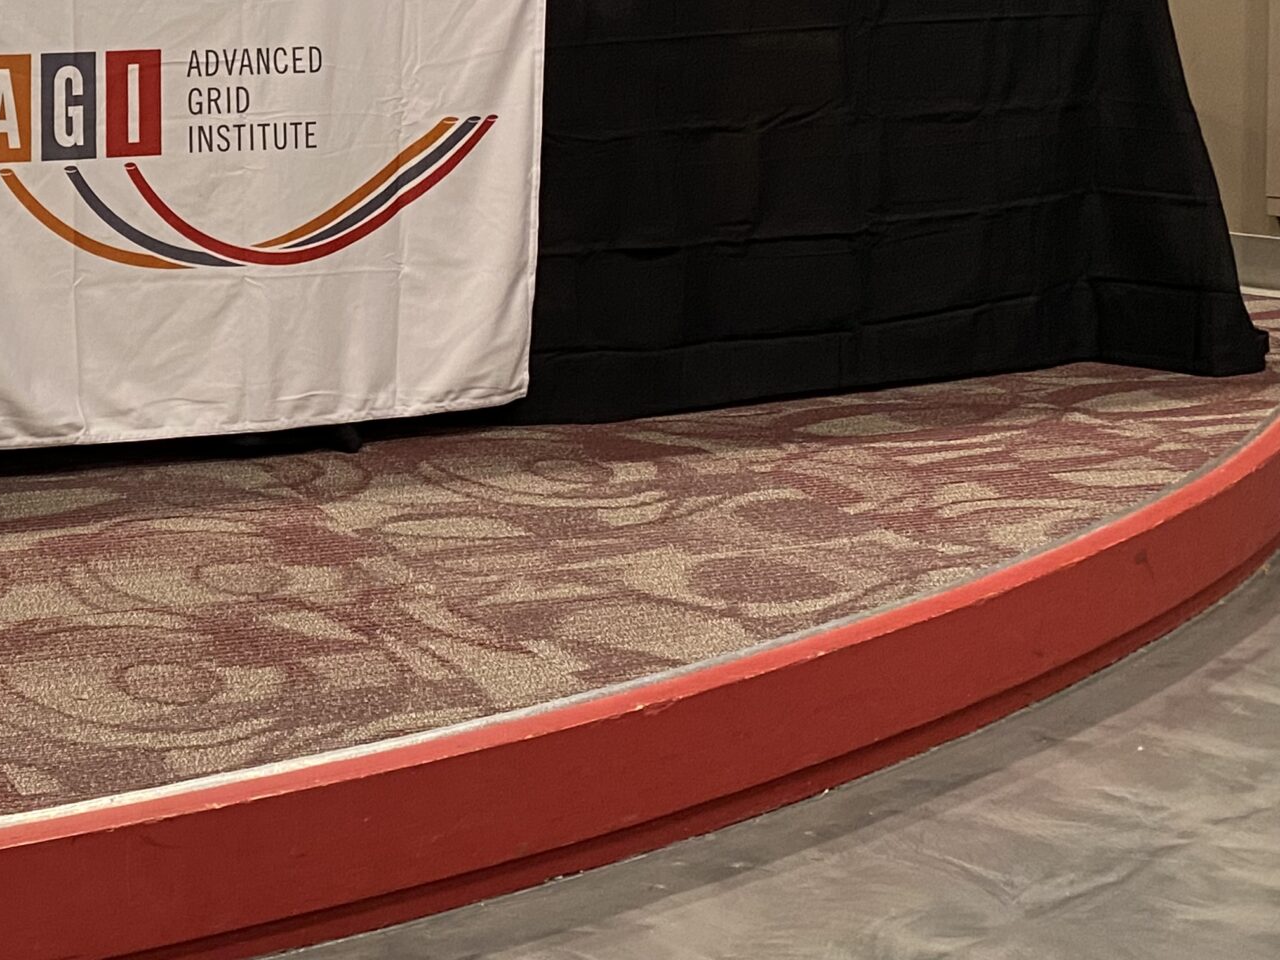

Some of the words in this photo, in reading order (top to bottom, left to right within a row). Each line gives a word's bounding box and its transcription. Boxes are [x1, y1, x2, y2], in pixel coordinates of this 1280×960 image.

[186, 45, 323, 78] ADVANCED
[187, 85, 251, 116] GRID
[188, 121, 318, 154] INSTITUTE
